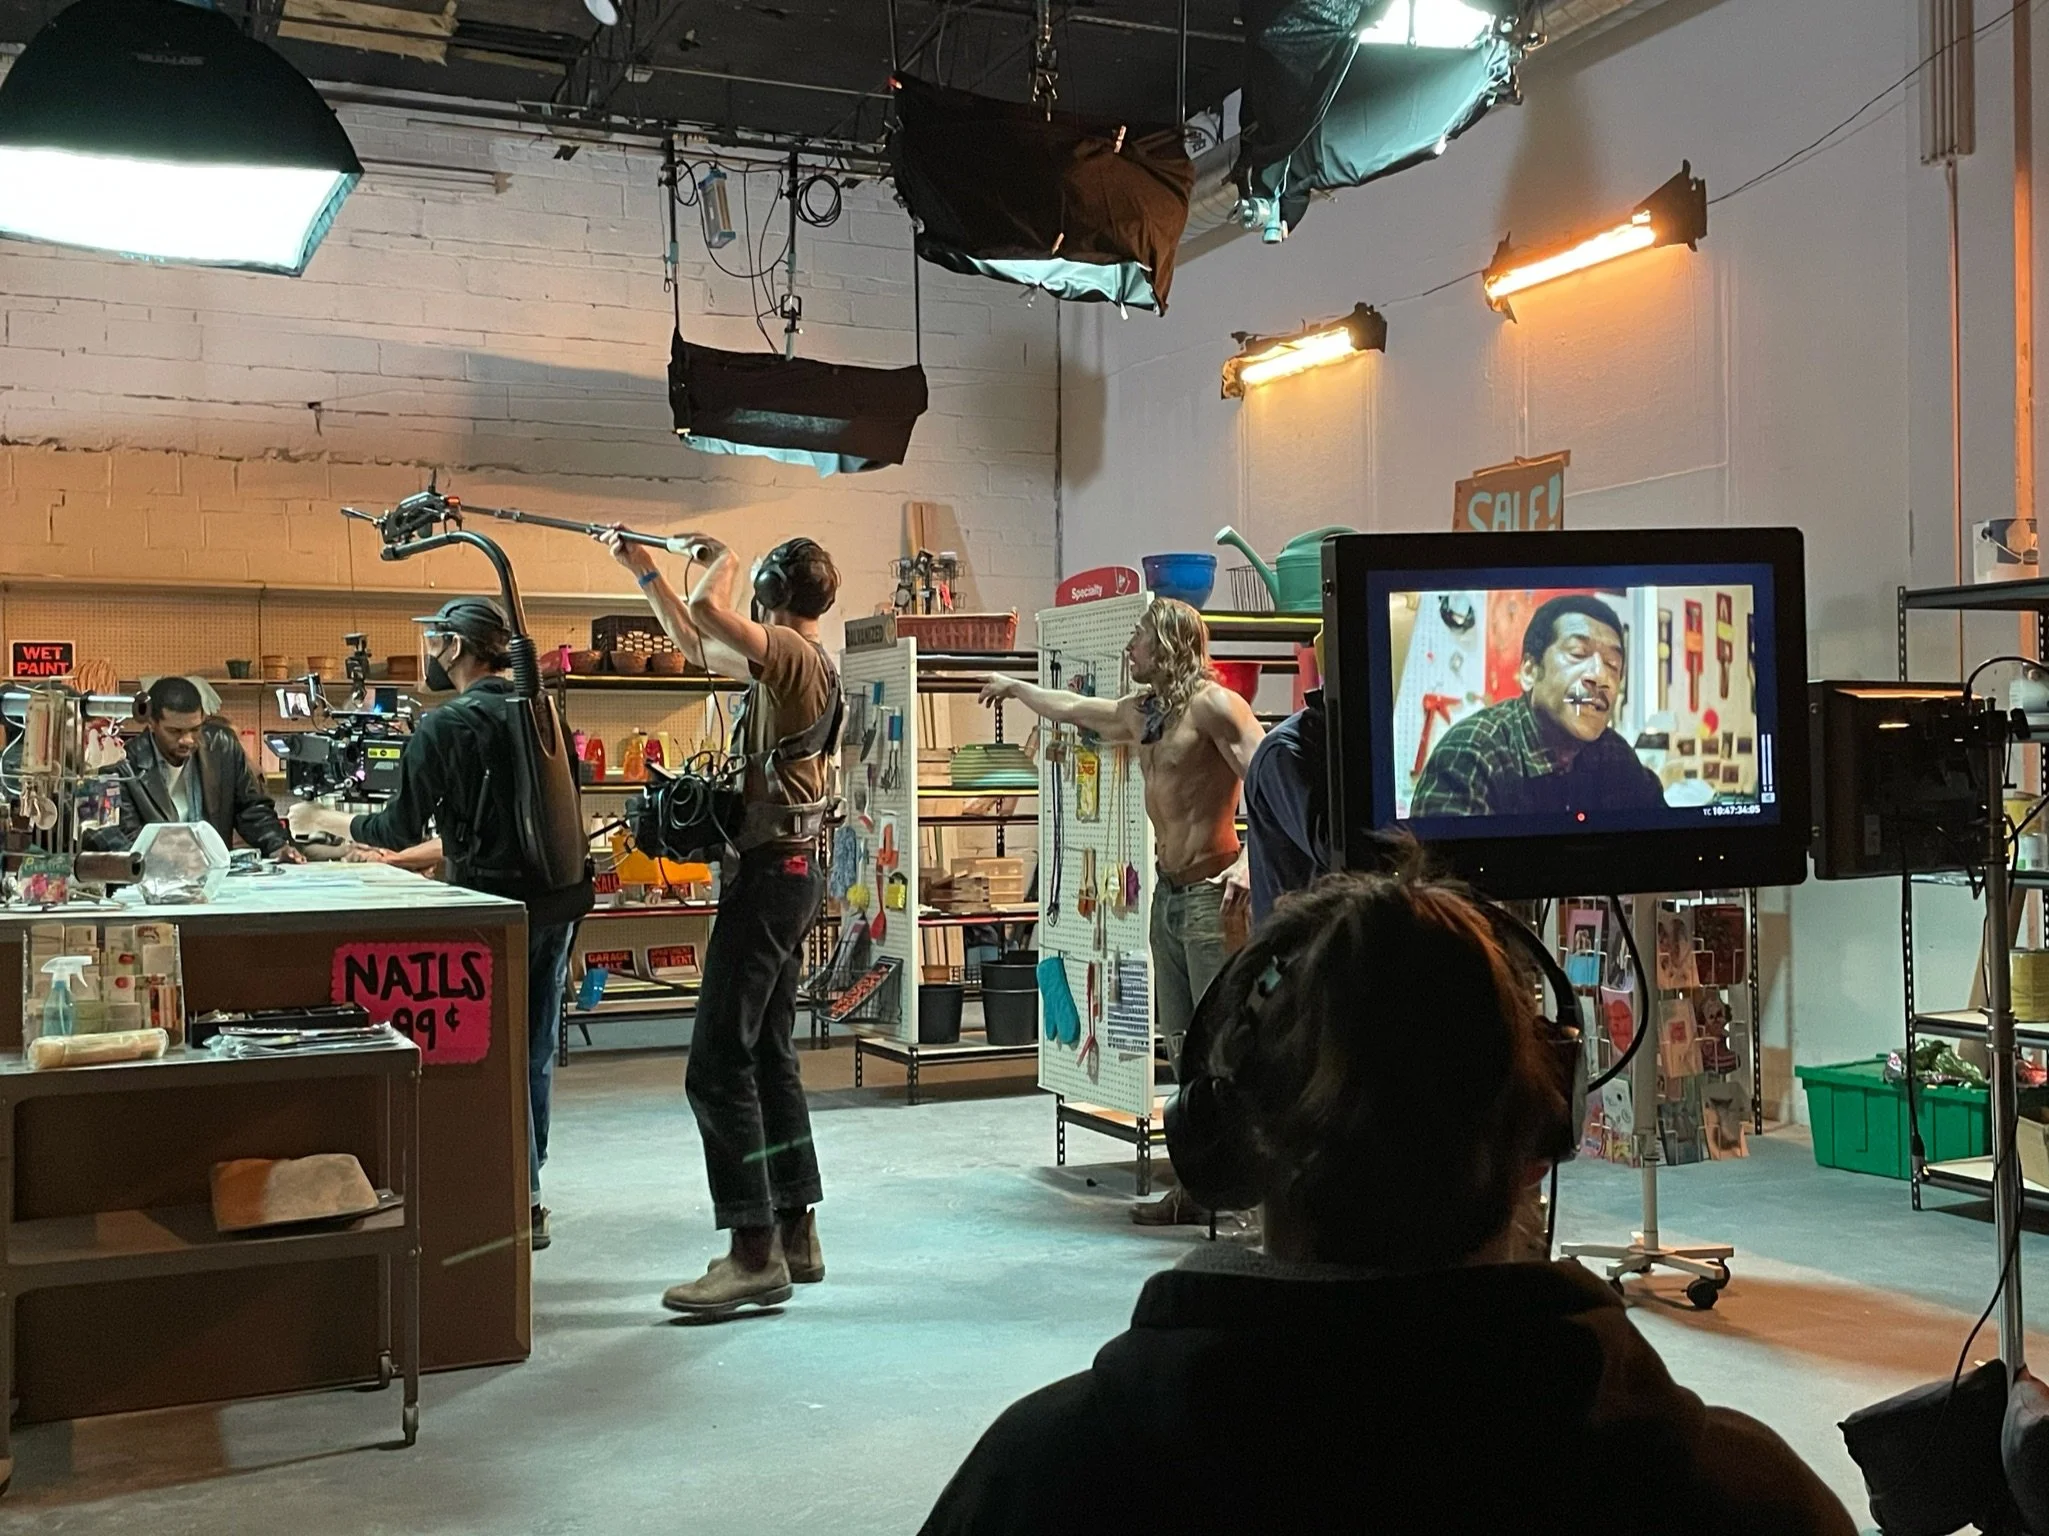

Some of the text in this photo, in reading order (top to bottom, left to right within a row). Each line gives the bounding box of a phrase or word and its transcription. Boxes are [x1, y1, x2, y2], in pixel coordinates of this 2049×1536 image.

[1468, 472, 1561, 532] SALE!
[1071, 584, 1103, 601] Specialty
[22, 645, 64, 660] WET
[16, 661, 69, 676] PAINT
[587, 952, 630, 964] GARAGE
[670, 954, 693, 966] RENT
[345, 951, 486, 1002] NAILS
